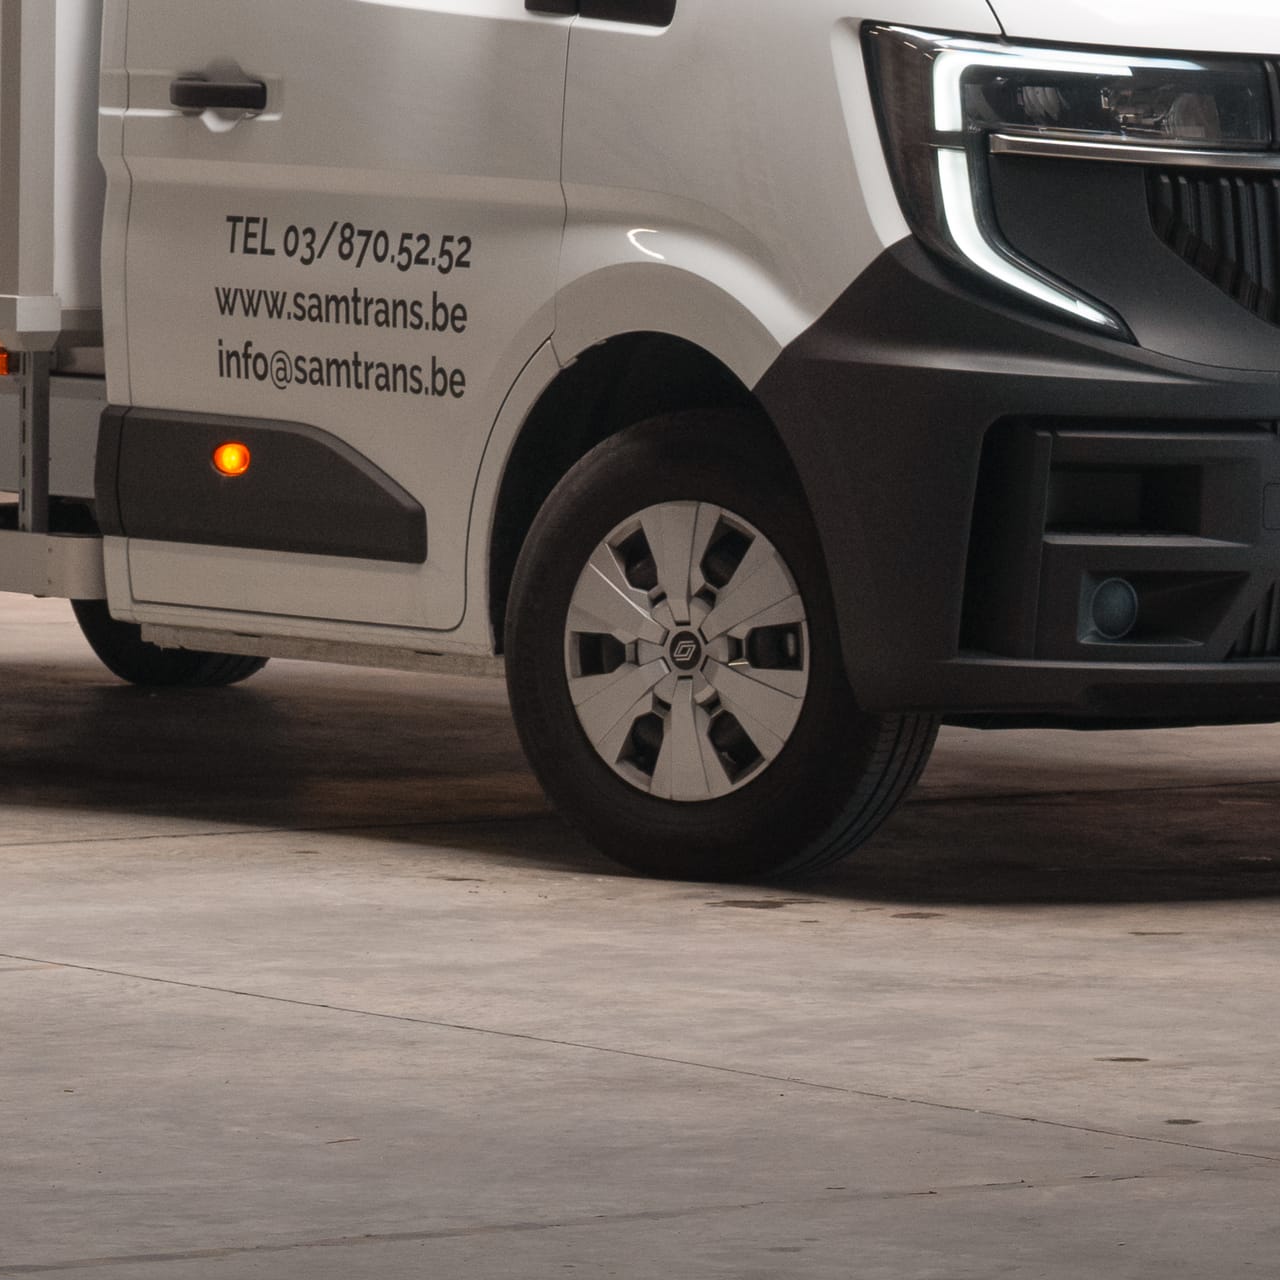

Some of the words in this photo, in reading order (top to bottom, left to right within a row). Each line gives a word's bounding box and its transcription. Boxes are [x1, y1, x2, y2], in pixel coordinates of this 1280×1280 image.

[226, 215, 276, 256] TEL
[283, 221, 472, 274] 03/870.52.52
[215, 286, 468, 333] www.samtrans.be
[218, 338, 466, 399] info@samtrans.be
